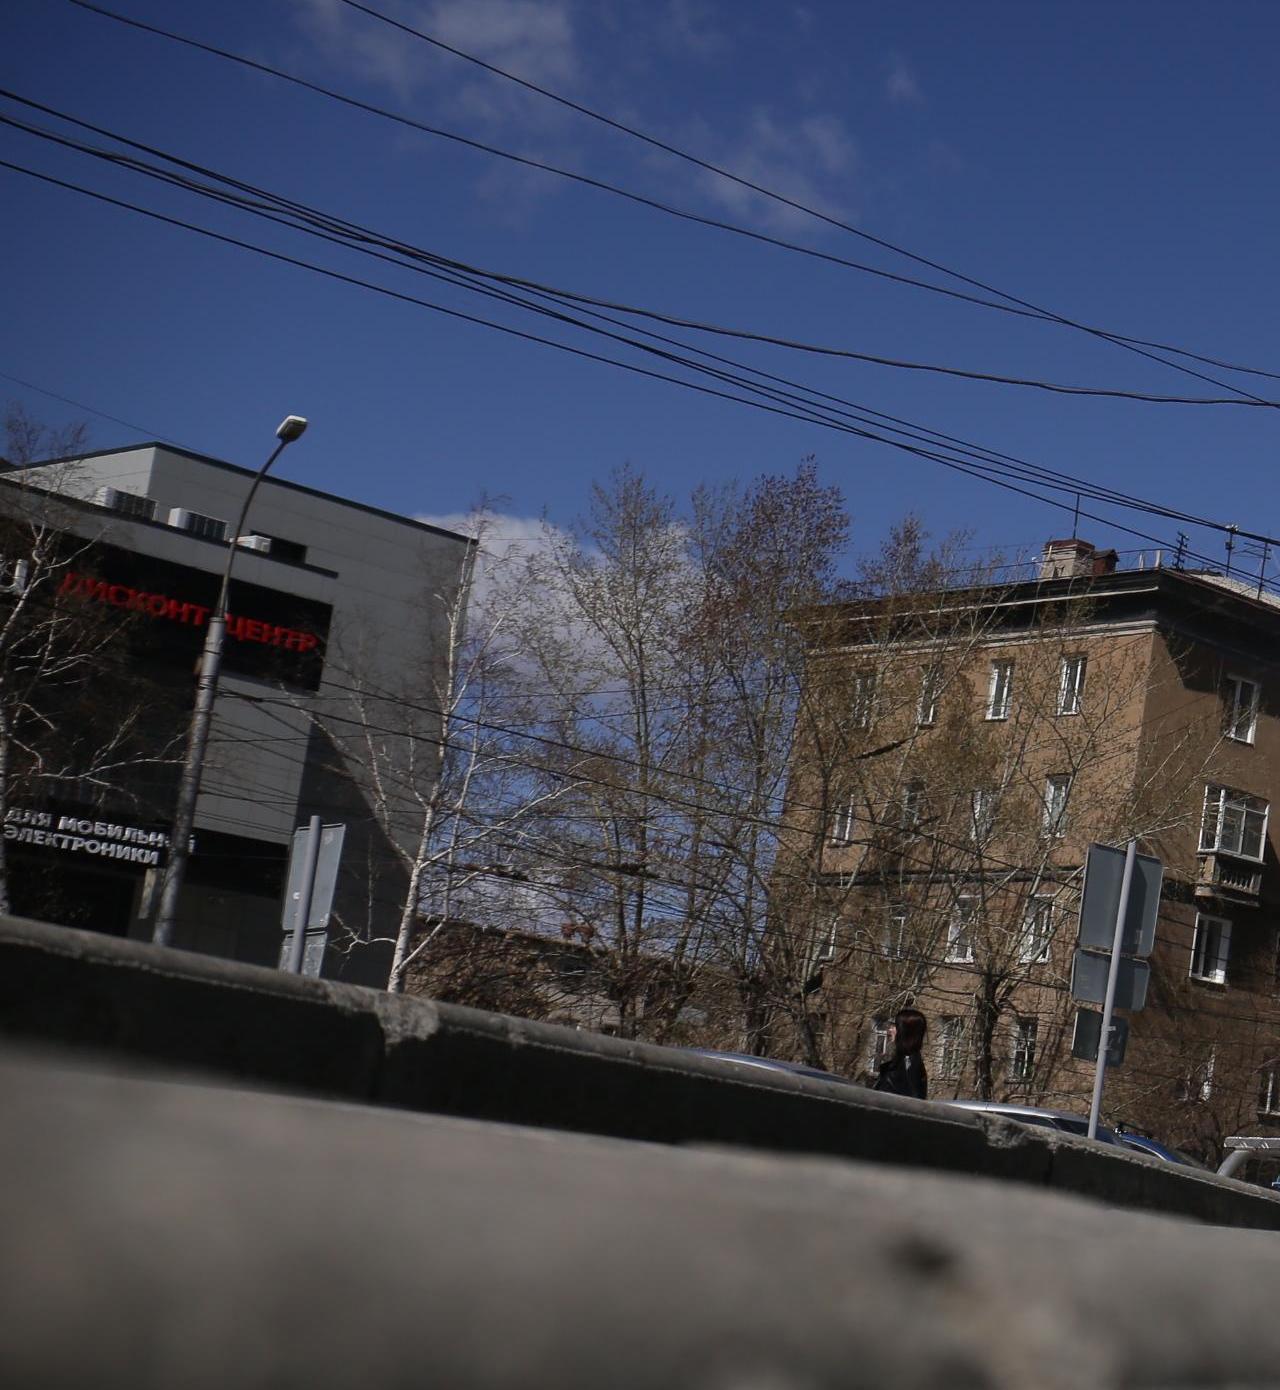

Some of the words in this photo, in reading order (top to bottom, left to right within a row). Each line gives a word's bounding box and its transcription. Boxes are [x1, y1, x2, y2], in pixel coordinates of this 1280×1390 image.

[57, 571, 210, 627] ДИСКОНТ
[226, 612, 320, 653] ЦЕНТР
[3, 824, 160, 865] ЭЛЕКТРОНИКИ
[4, 806, 53, 828] ДЛЯ
[57, 816, 195, 853] МОБИЛЬН
